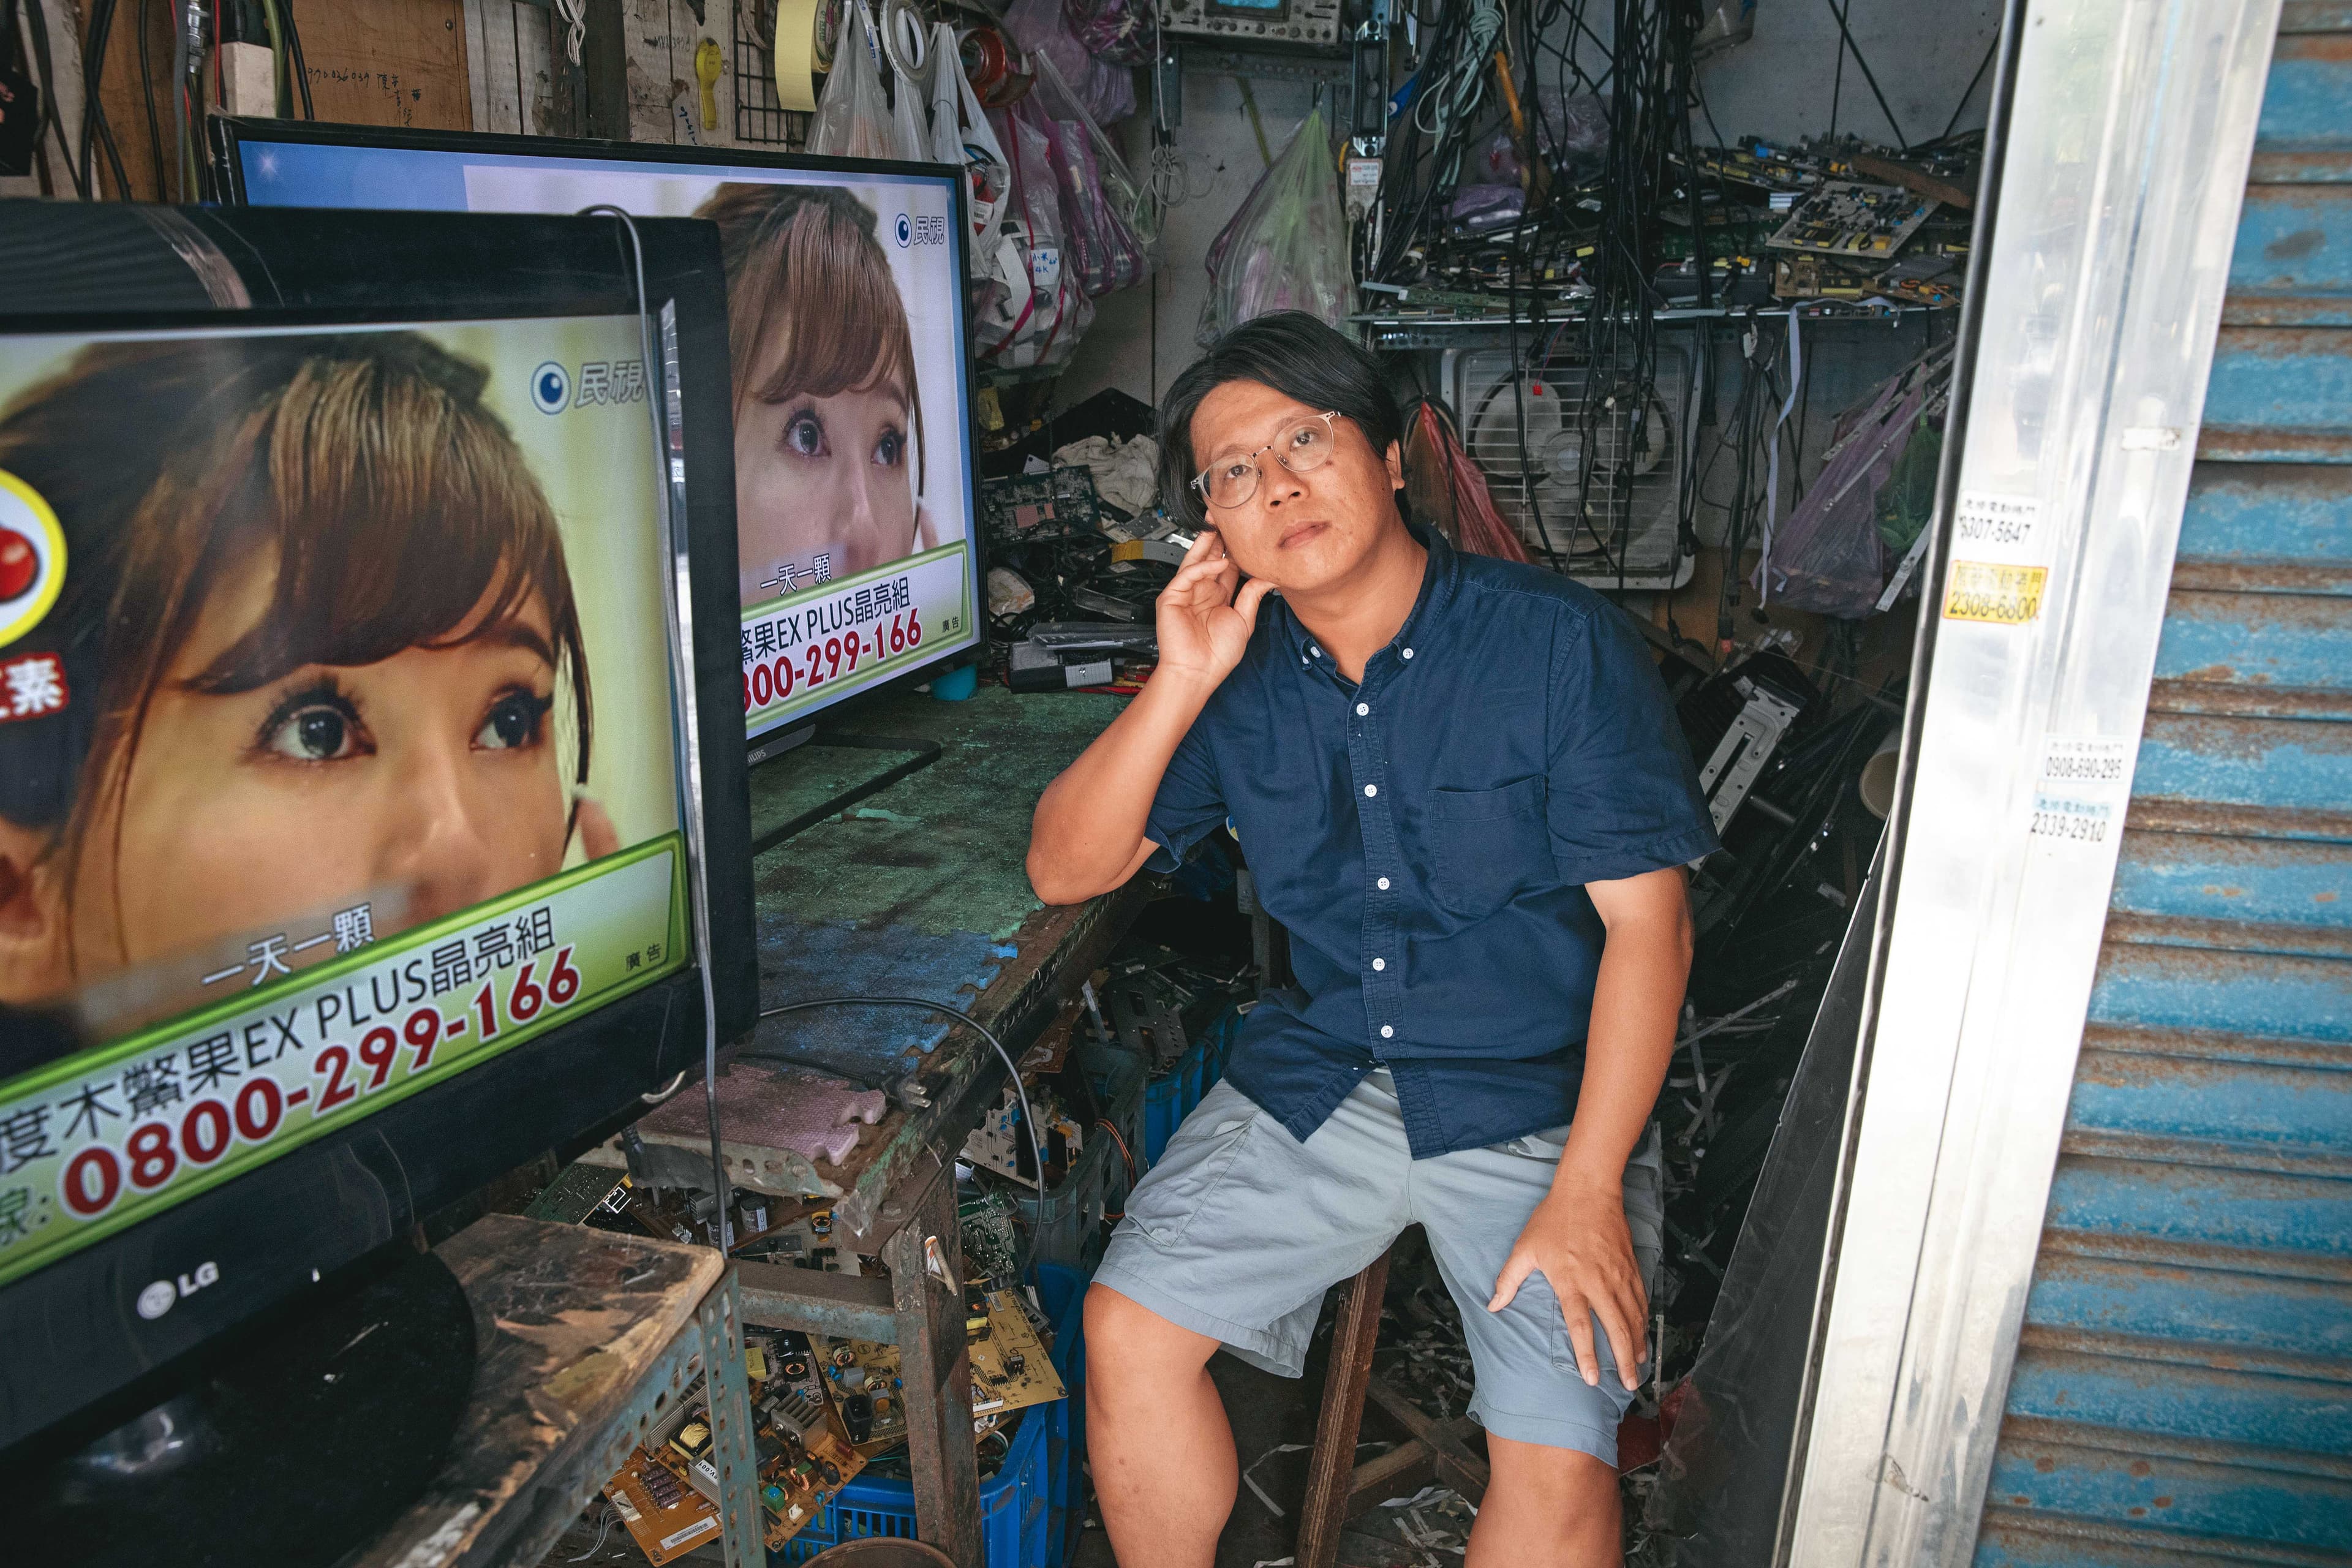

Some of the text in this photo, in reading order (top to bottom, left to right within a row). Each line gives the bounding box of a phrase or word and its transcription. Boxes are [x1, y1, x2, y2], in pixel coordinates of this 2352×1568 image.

[913, 216, 945, 245] 民視
[574, 359, 643, 409] 民視
[760, 554, 832, 596] 一天一顆
[807, 577, 911, 637] PLUS晶亮組
[1950, 590, 2038, 621] 2308-6800
[942, 616, 960, 633] 廣告
[747, 749, 766, 763] ILIPS
[2046, 756, 2122, 780] 0908-690-295
[2030, 812, 2107, 843] 2339-2910
[202, 902, 376, 987] 一天一顆
[625, 943, 662, 973] 廣告
[317, 907, 556, 1040] PLUS晶亮組
[62, 947, 580, 1215] 0800-299-166
[179, 1261, 219, 1297] LG
